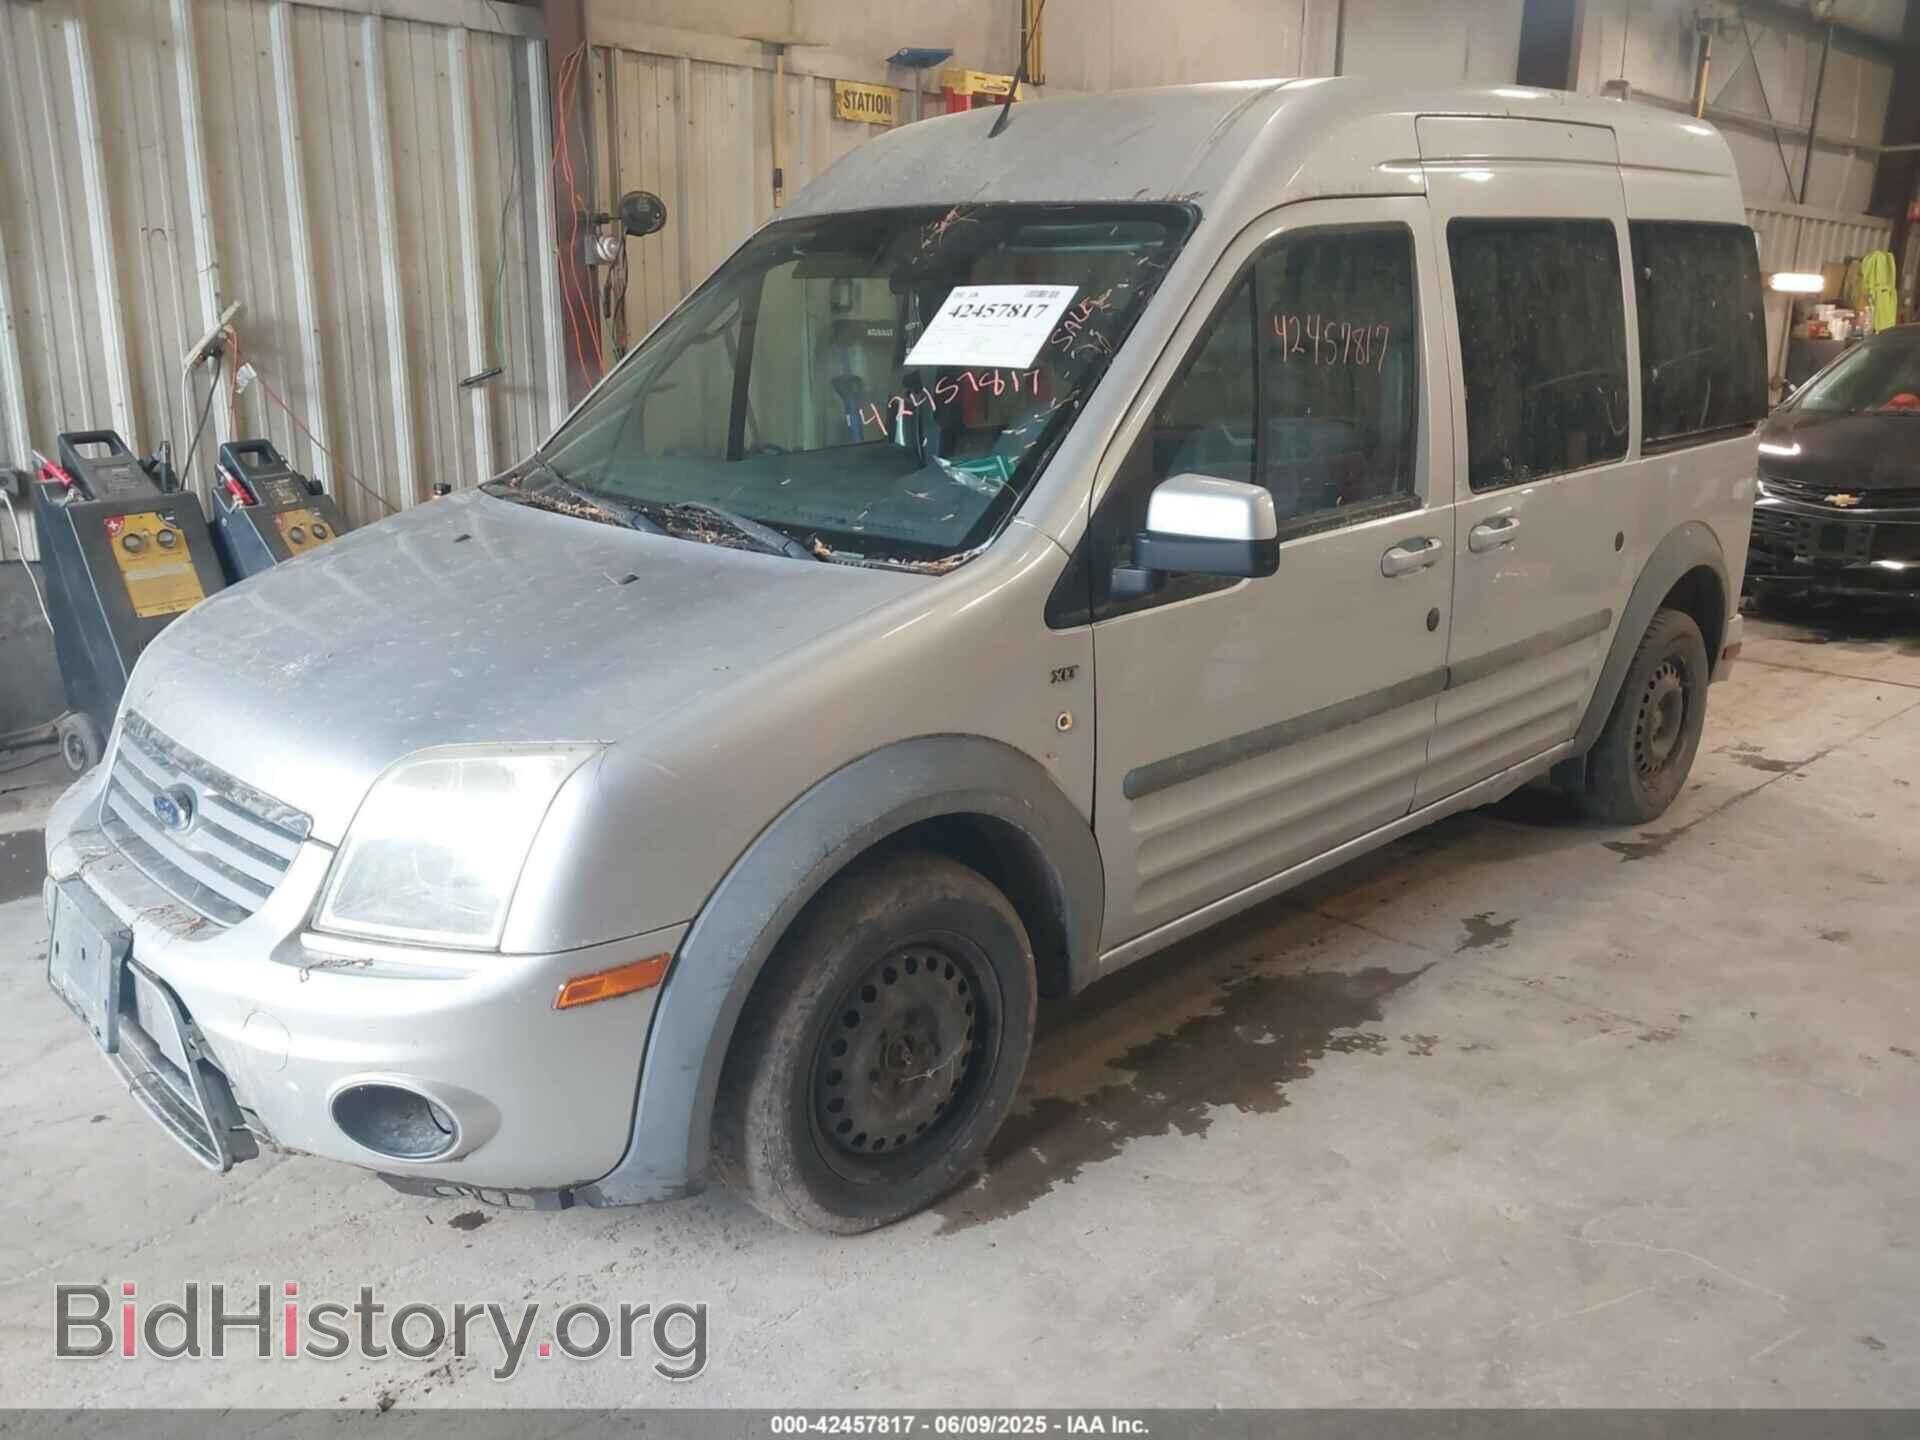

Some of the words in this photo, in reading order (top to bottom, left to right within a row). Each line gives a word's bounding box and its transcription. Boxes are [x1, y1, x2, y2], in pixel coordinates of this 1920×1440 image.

[842, 88, 892, 115] STATION
[948, 303, 1049, 319] 42457817
[1274, 313, 1390, 375] 42457817
[859, 369, 1040, 436] 42457817
